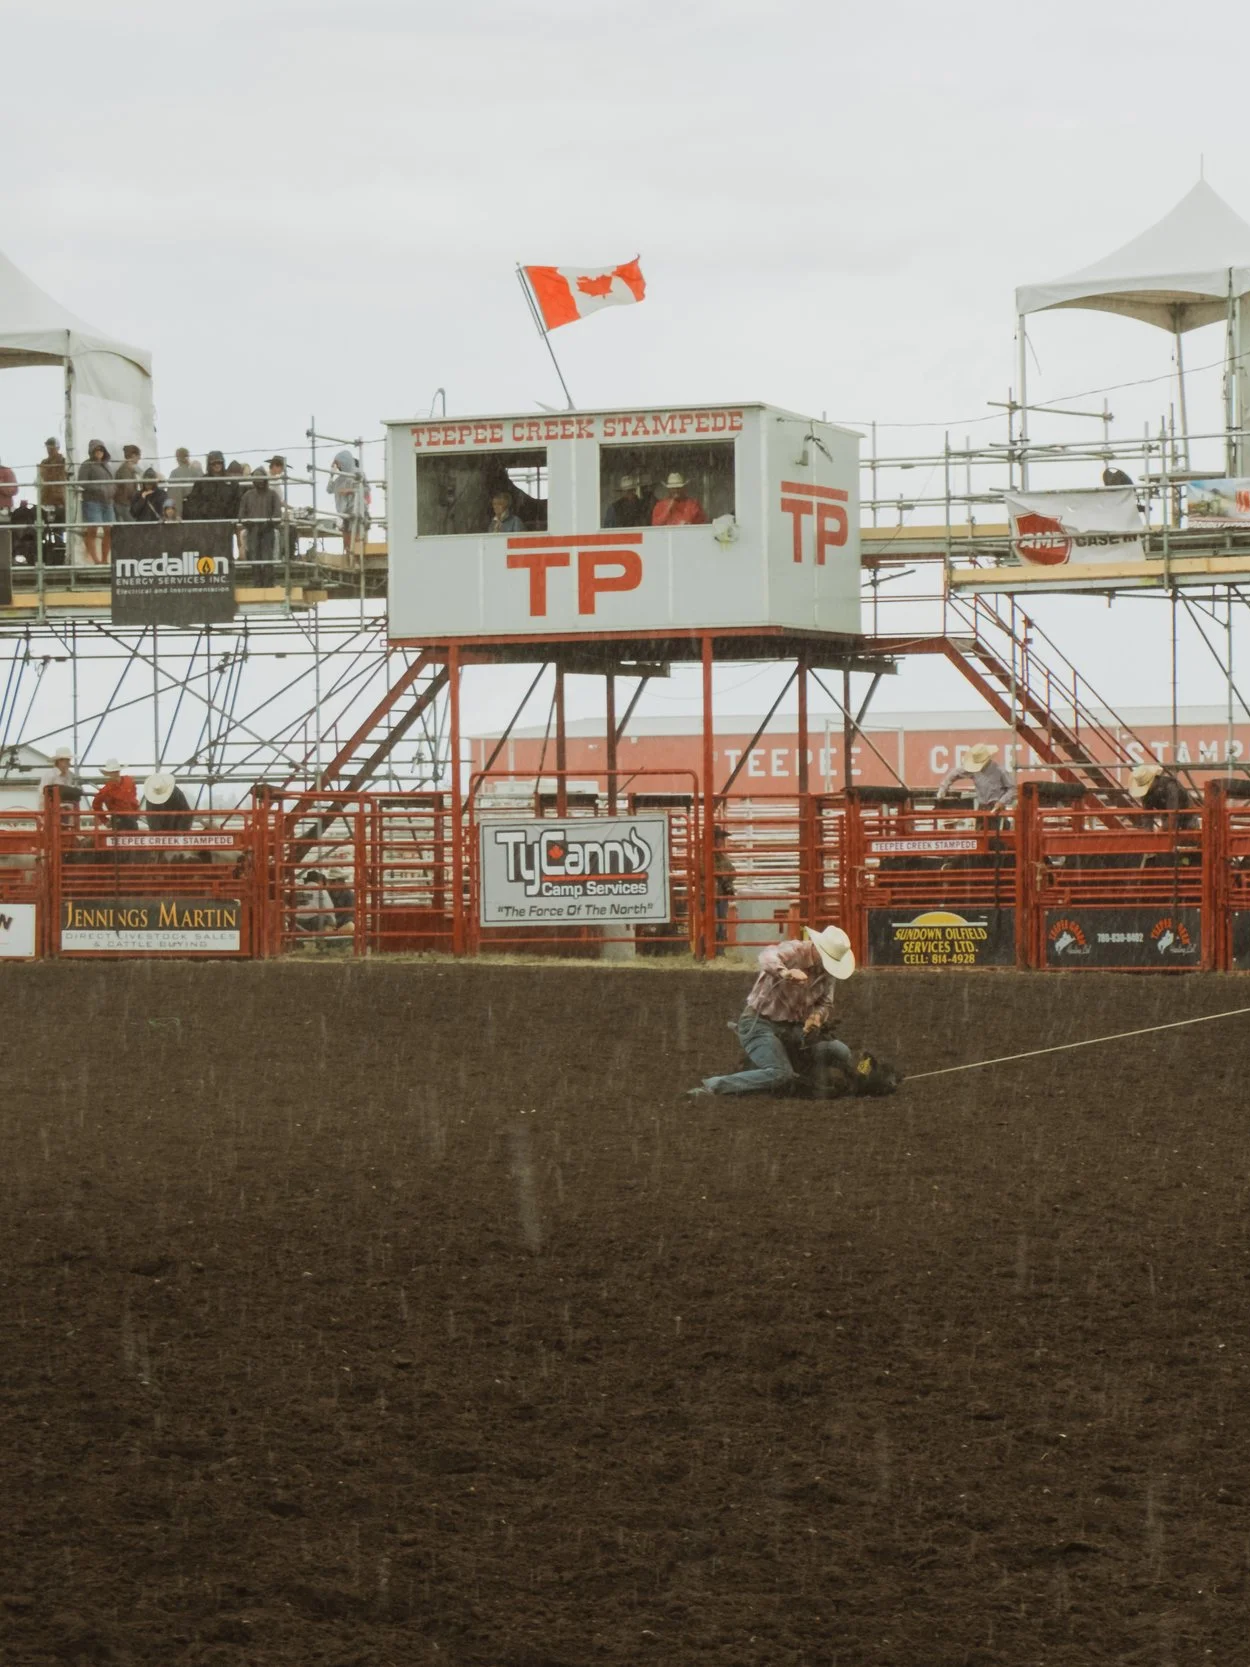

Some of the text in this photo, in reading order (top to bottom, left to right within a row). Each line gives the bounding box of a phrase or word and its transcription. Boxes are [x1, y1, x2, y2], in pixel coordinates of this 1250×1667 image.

[411, 411, 744, 447] TEEPEE CREEK STAMPEDE
[780, 497, 848, 565] TP
[116, 551, 229, 577] medallion
[116, 577, 154, 586] ENERGY
[158, 576, 206, 585] SERVICES
[507, 549, 643, 617] TP
[116, 587, 151, 595] Electrical
[170, 586, 230, 594] Instrumentation
[149, 837, 180, 845] CREEK
[183, 836, 233, 845] STAMPEDE
[875, 840, 976, 851] TEEPEE CREEK STAMPEDE
[541, 880, 649, 899] Camp Services
[64, 901, 236, 928] JENNINGS MARTIN
[529, 905, 563, 917] Force
[567, 904, 582, 916] Of
[586, 904, 608, 916] The
[894, 928, 988, 940] SUNDOWN OILFIELD
[902, 941, 979, 953] SERVICES LTD.
[904, 954, 975, 964] CELL: 814-4928
